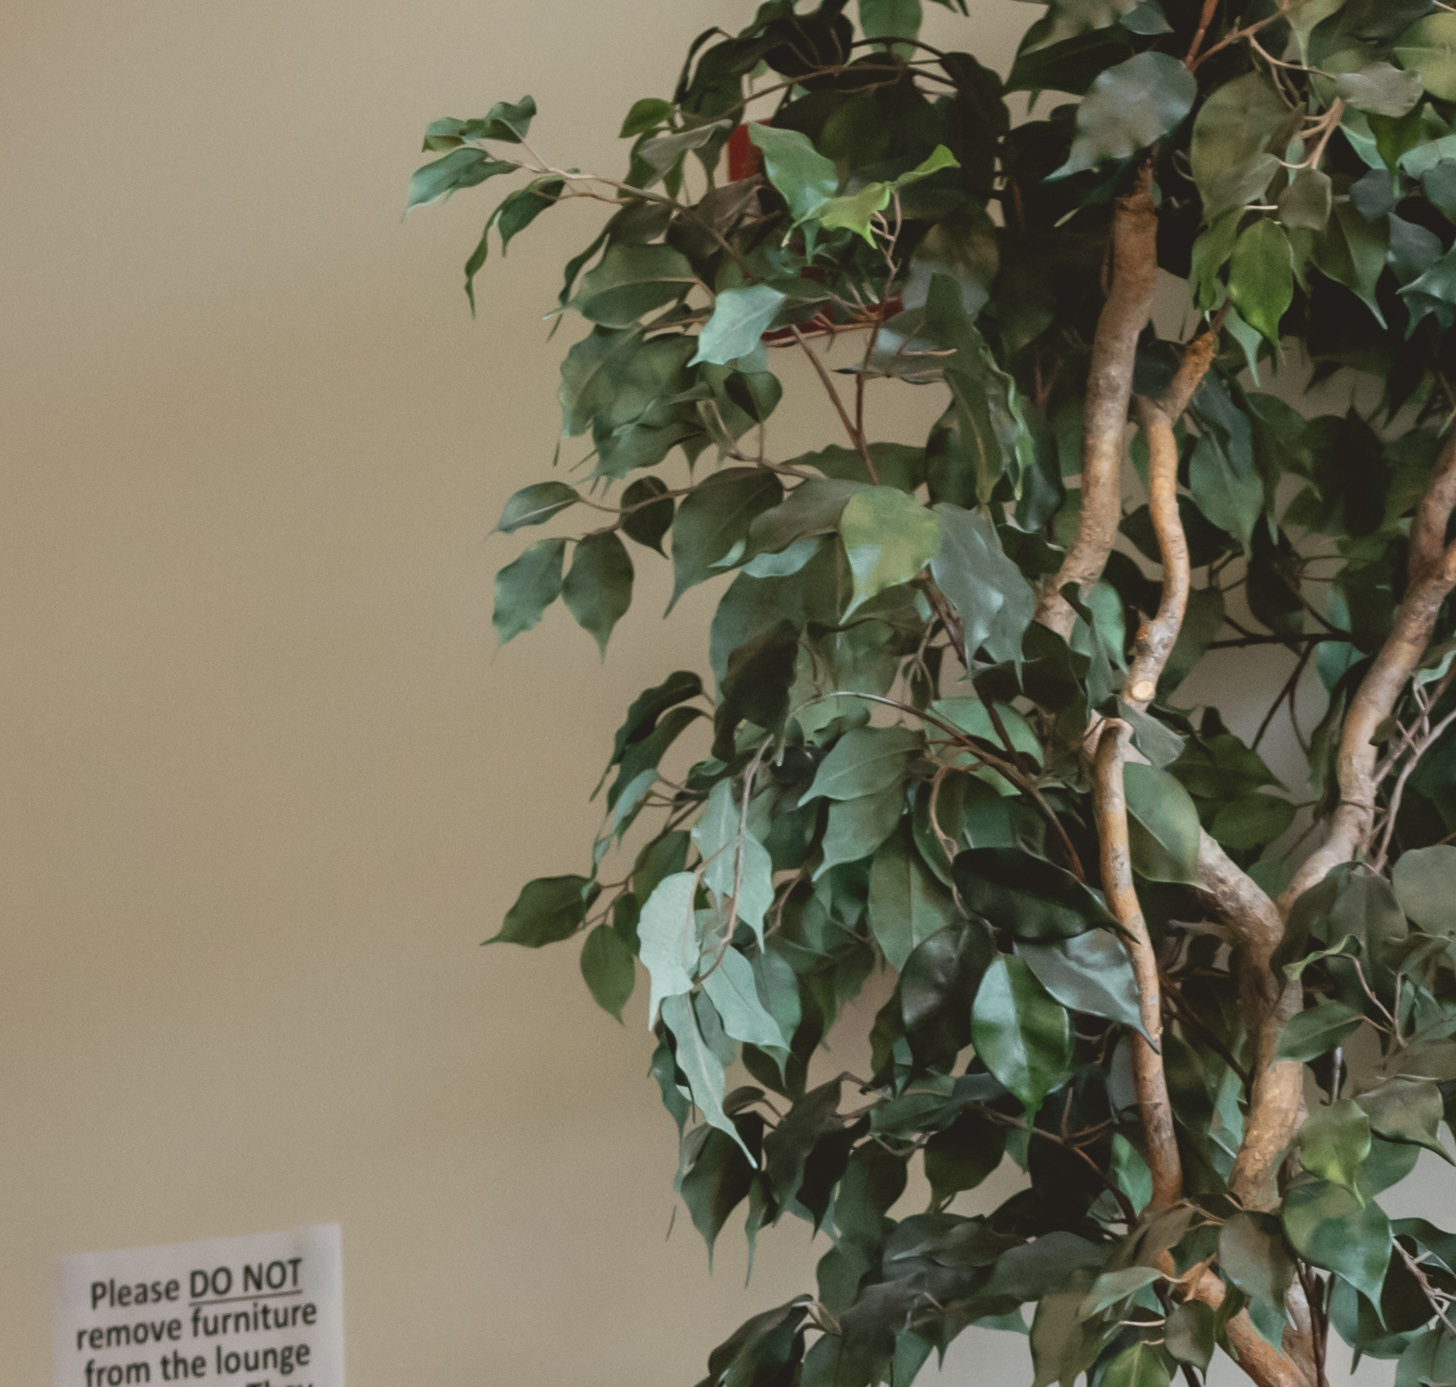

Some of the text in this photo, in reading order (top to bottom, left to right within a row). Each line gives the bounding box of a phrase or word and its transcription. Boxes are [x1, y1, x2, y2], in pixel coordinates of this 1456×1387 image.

[90, 1258, 303, 1310] Please DO NOT
[76, 1299, 317, 1351] remove furniture
[161, 1348, 206, 1381] the
[216, 1341, 311, 1378] lounge
